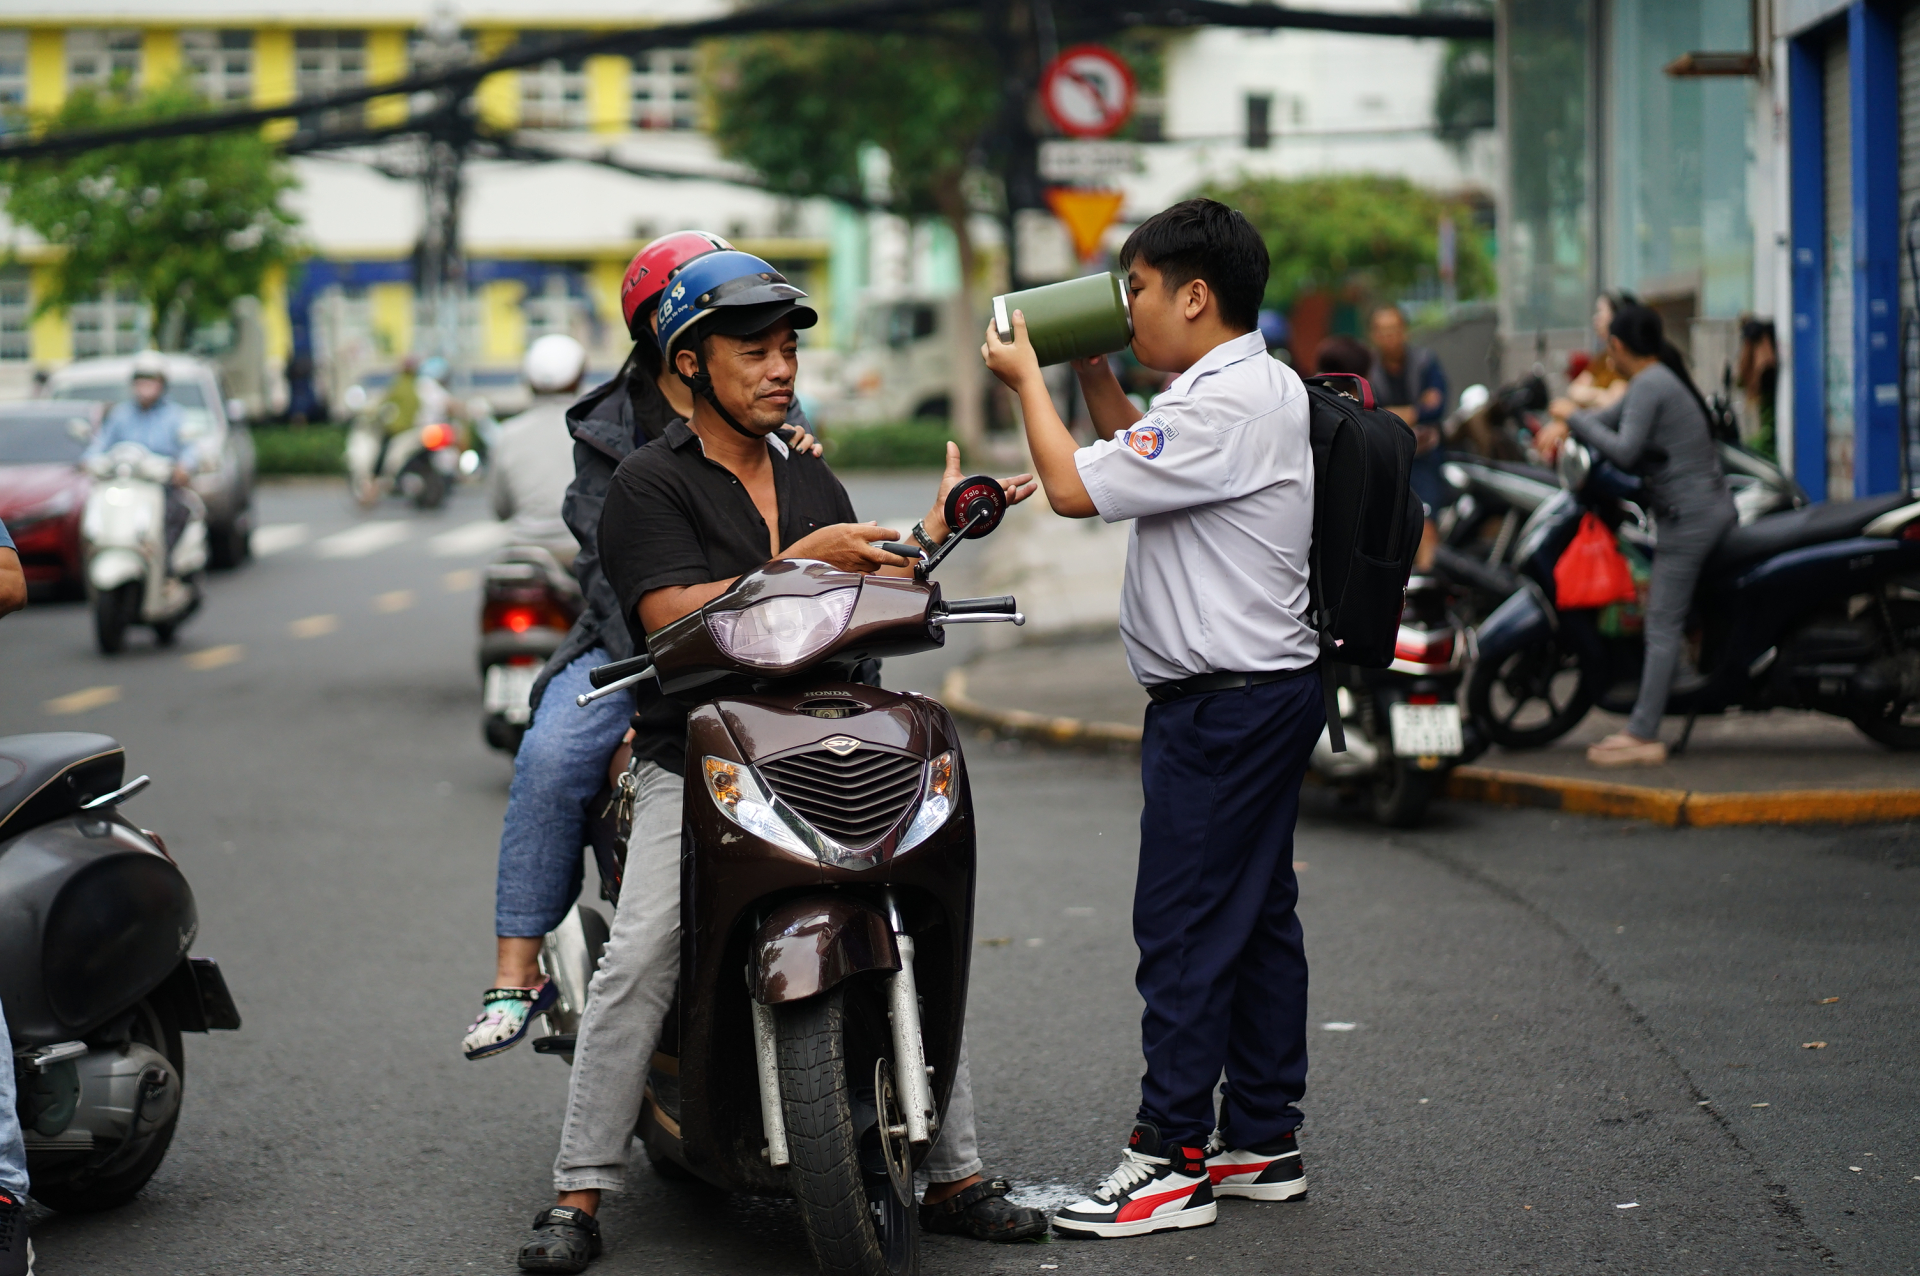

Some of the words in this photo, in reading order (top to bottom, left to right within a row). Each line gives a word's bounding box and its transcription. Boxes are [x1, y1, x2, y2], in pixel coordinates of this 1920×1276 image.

[964, 489, 980, 500] Zalo
[990, 492, 999, 507] Zalo
[804, 690, 853, 698] HONDA
